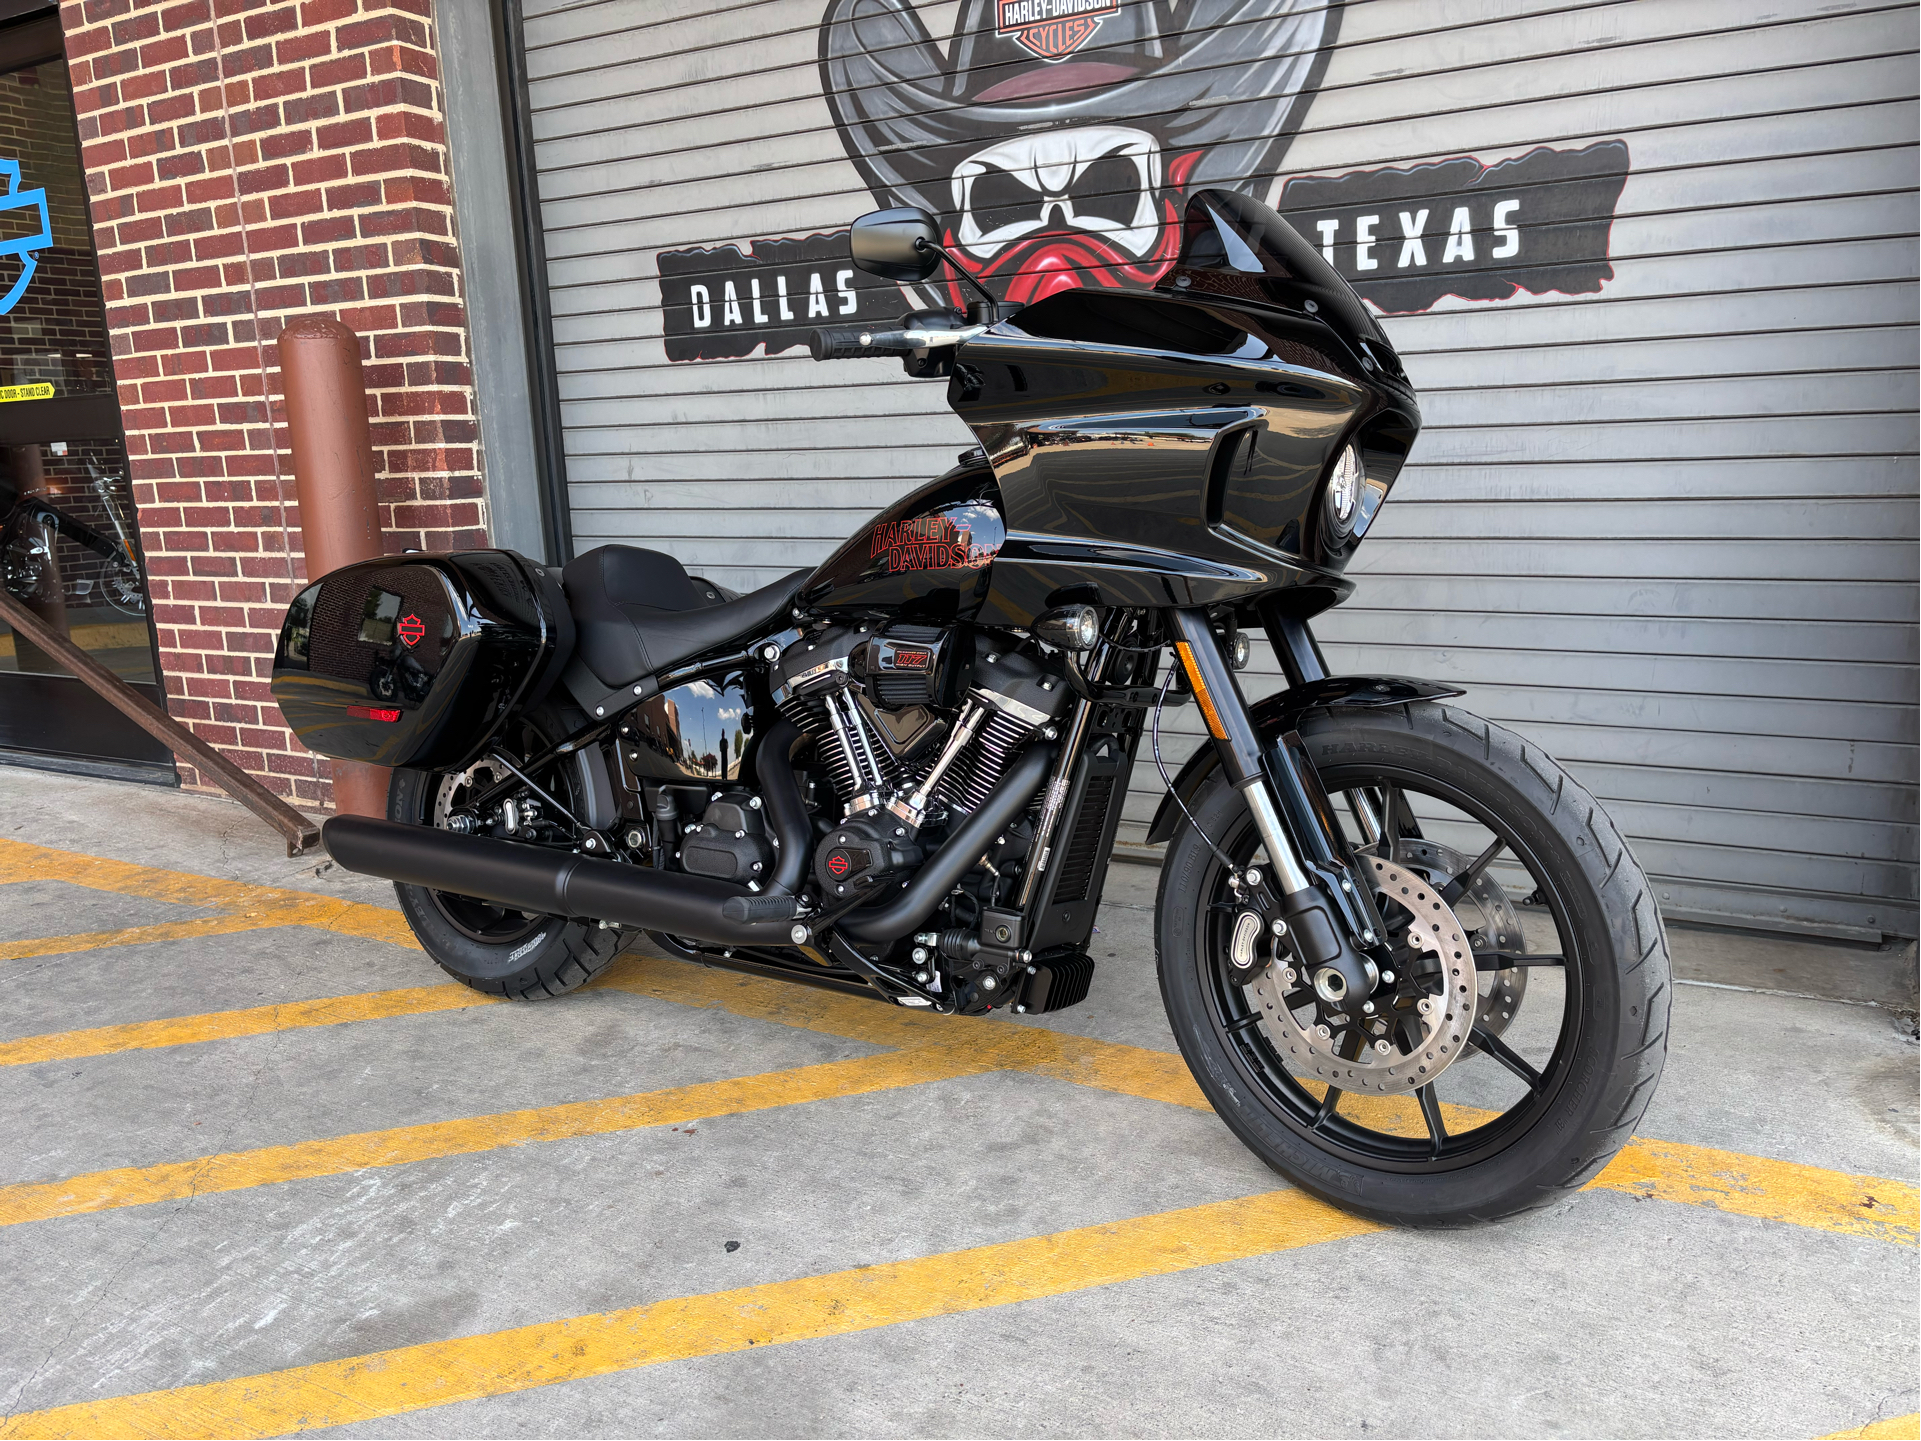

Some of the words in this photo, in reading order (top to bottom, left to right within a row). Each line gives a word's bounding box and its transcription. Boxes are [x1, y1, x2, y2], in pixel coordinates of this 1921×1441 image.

[1029, 19, 1085, 53] CYCLES
[1316, 199, 1520, 271] TEXAS
[690, 269, 857, 328] DALLAS
[4, 388, 17, 399] DOOR
[20, 387, 35, 398] STAND
[35, 385, 50, 396] CLEAR
[897, 653, 927, 664] 117
[1178, 861, 1194, 894] 110/90
[1188, 843, 1201, 864] B19
[1239, 1102, 1336, 1182] MICHELIN
